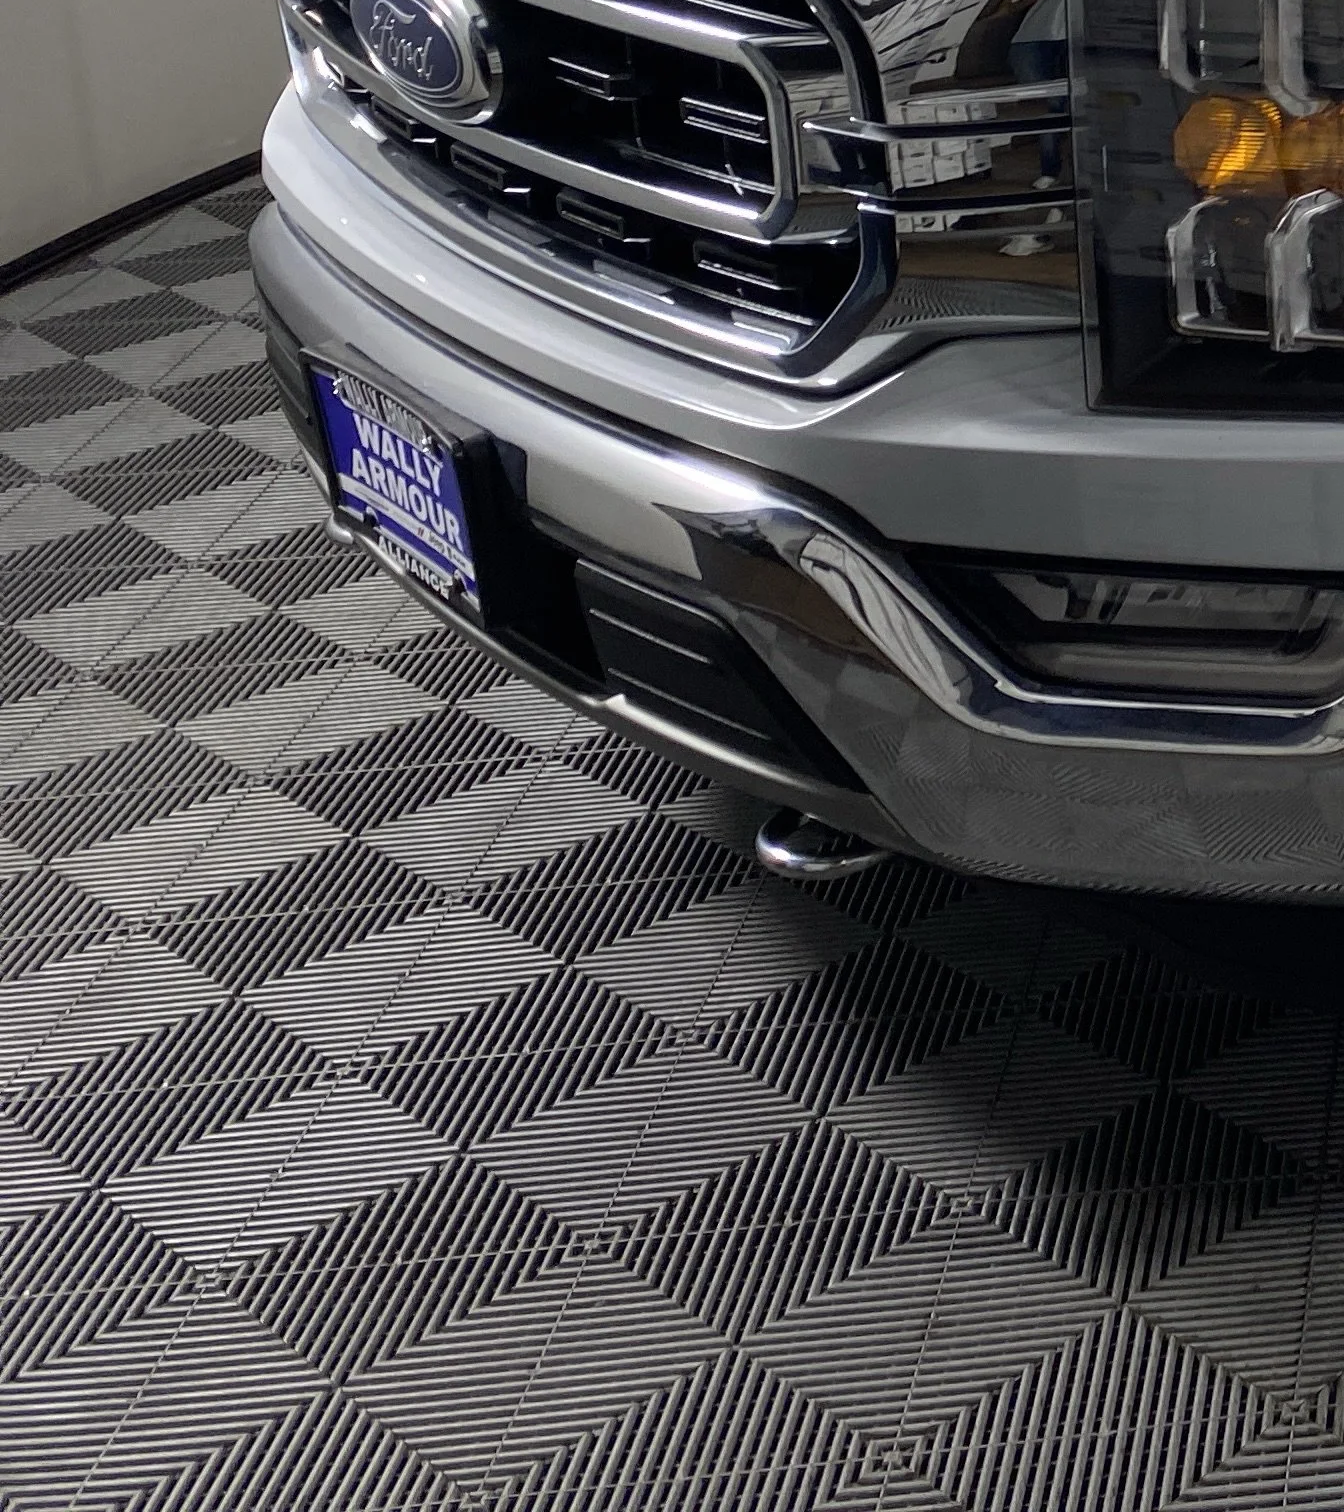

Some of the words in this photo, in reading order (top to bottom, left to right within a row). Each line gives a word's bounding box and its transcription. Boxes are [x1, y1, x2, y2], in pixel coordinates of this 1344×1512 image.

[370, 0, 433, 80] Ford
[353, 411, 442, 497] WALLY
[352, 448, 464, 552] ARMOUR
[378, 535, 450, 600] ALLIANCE
